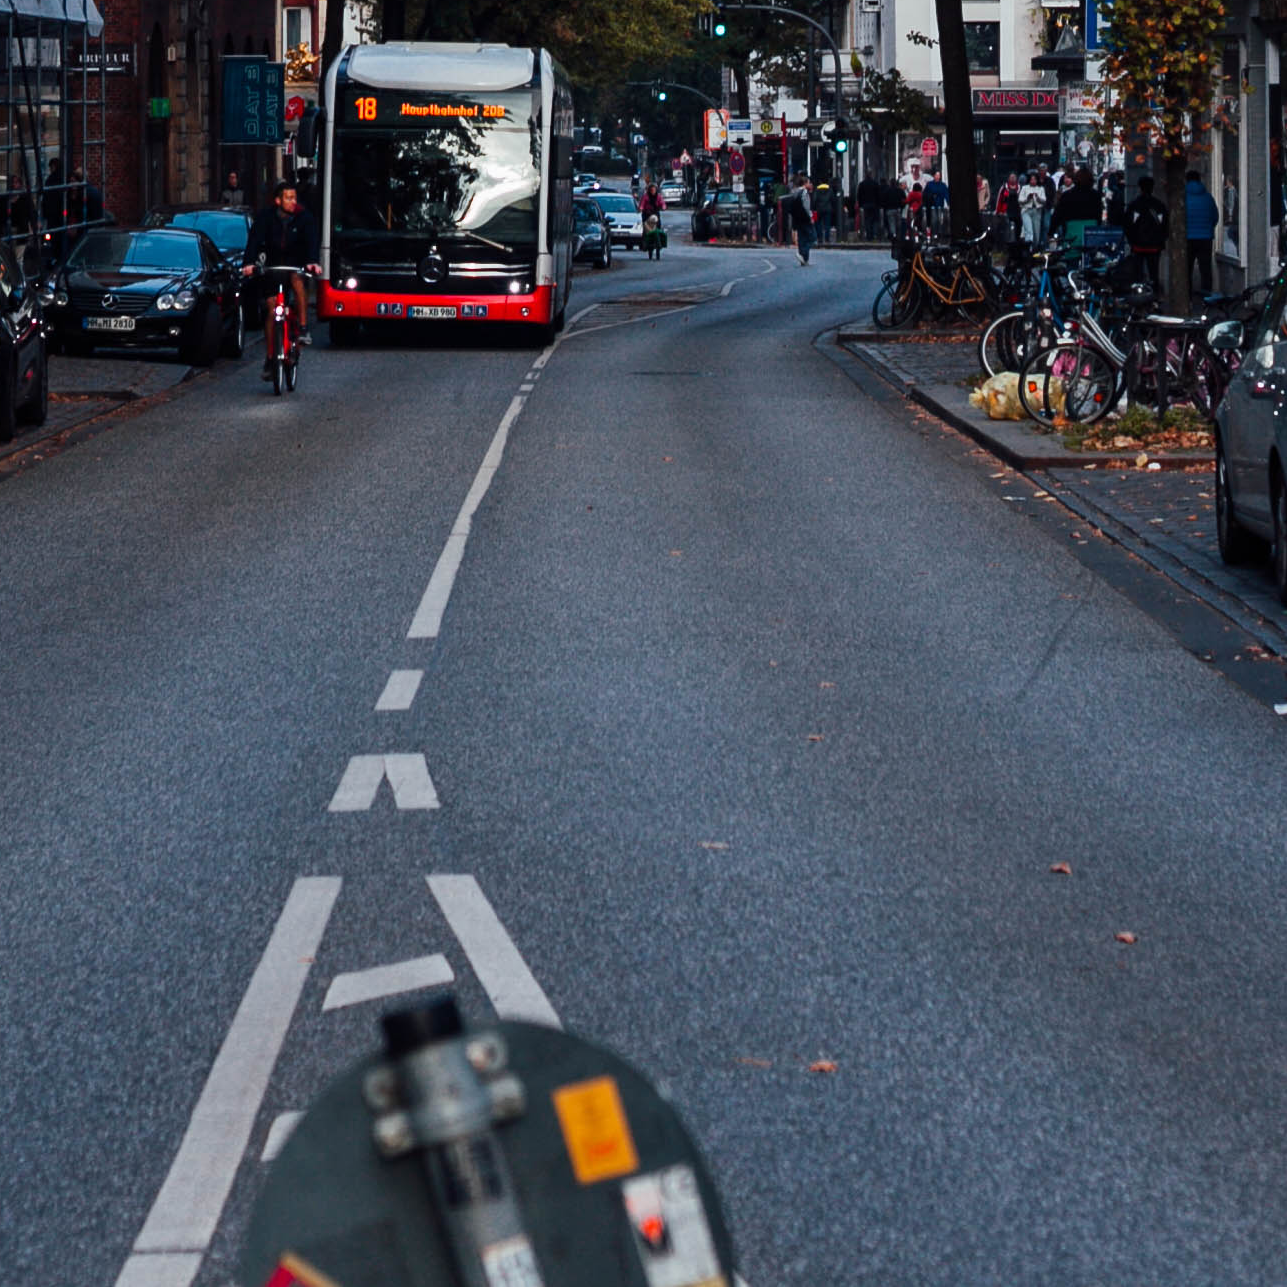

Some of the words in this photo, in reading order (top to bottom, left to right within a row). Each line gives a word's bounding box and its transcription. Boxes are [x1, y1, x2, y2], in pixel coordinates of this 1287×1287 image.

[354, 97, 377, 120] 18
[400, 102, 478, 117] Hauptbahnhof
[977, 91, 1029, 107] MISS
